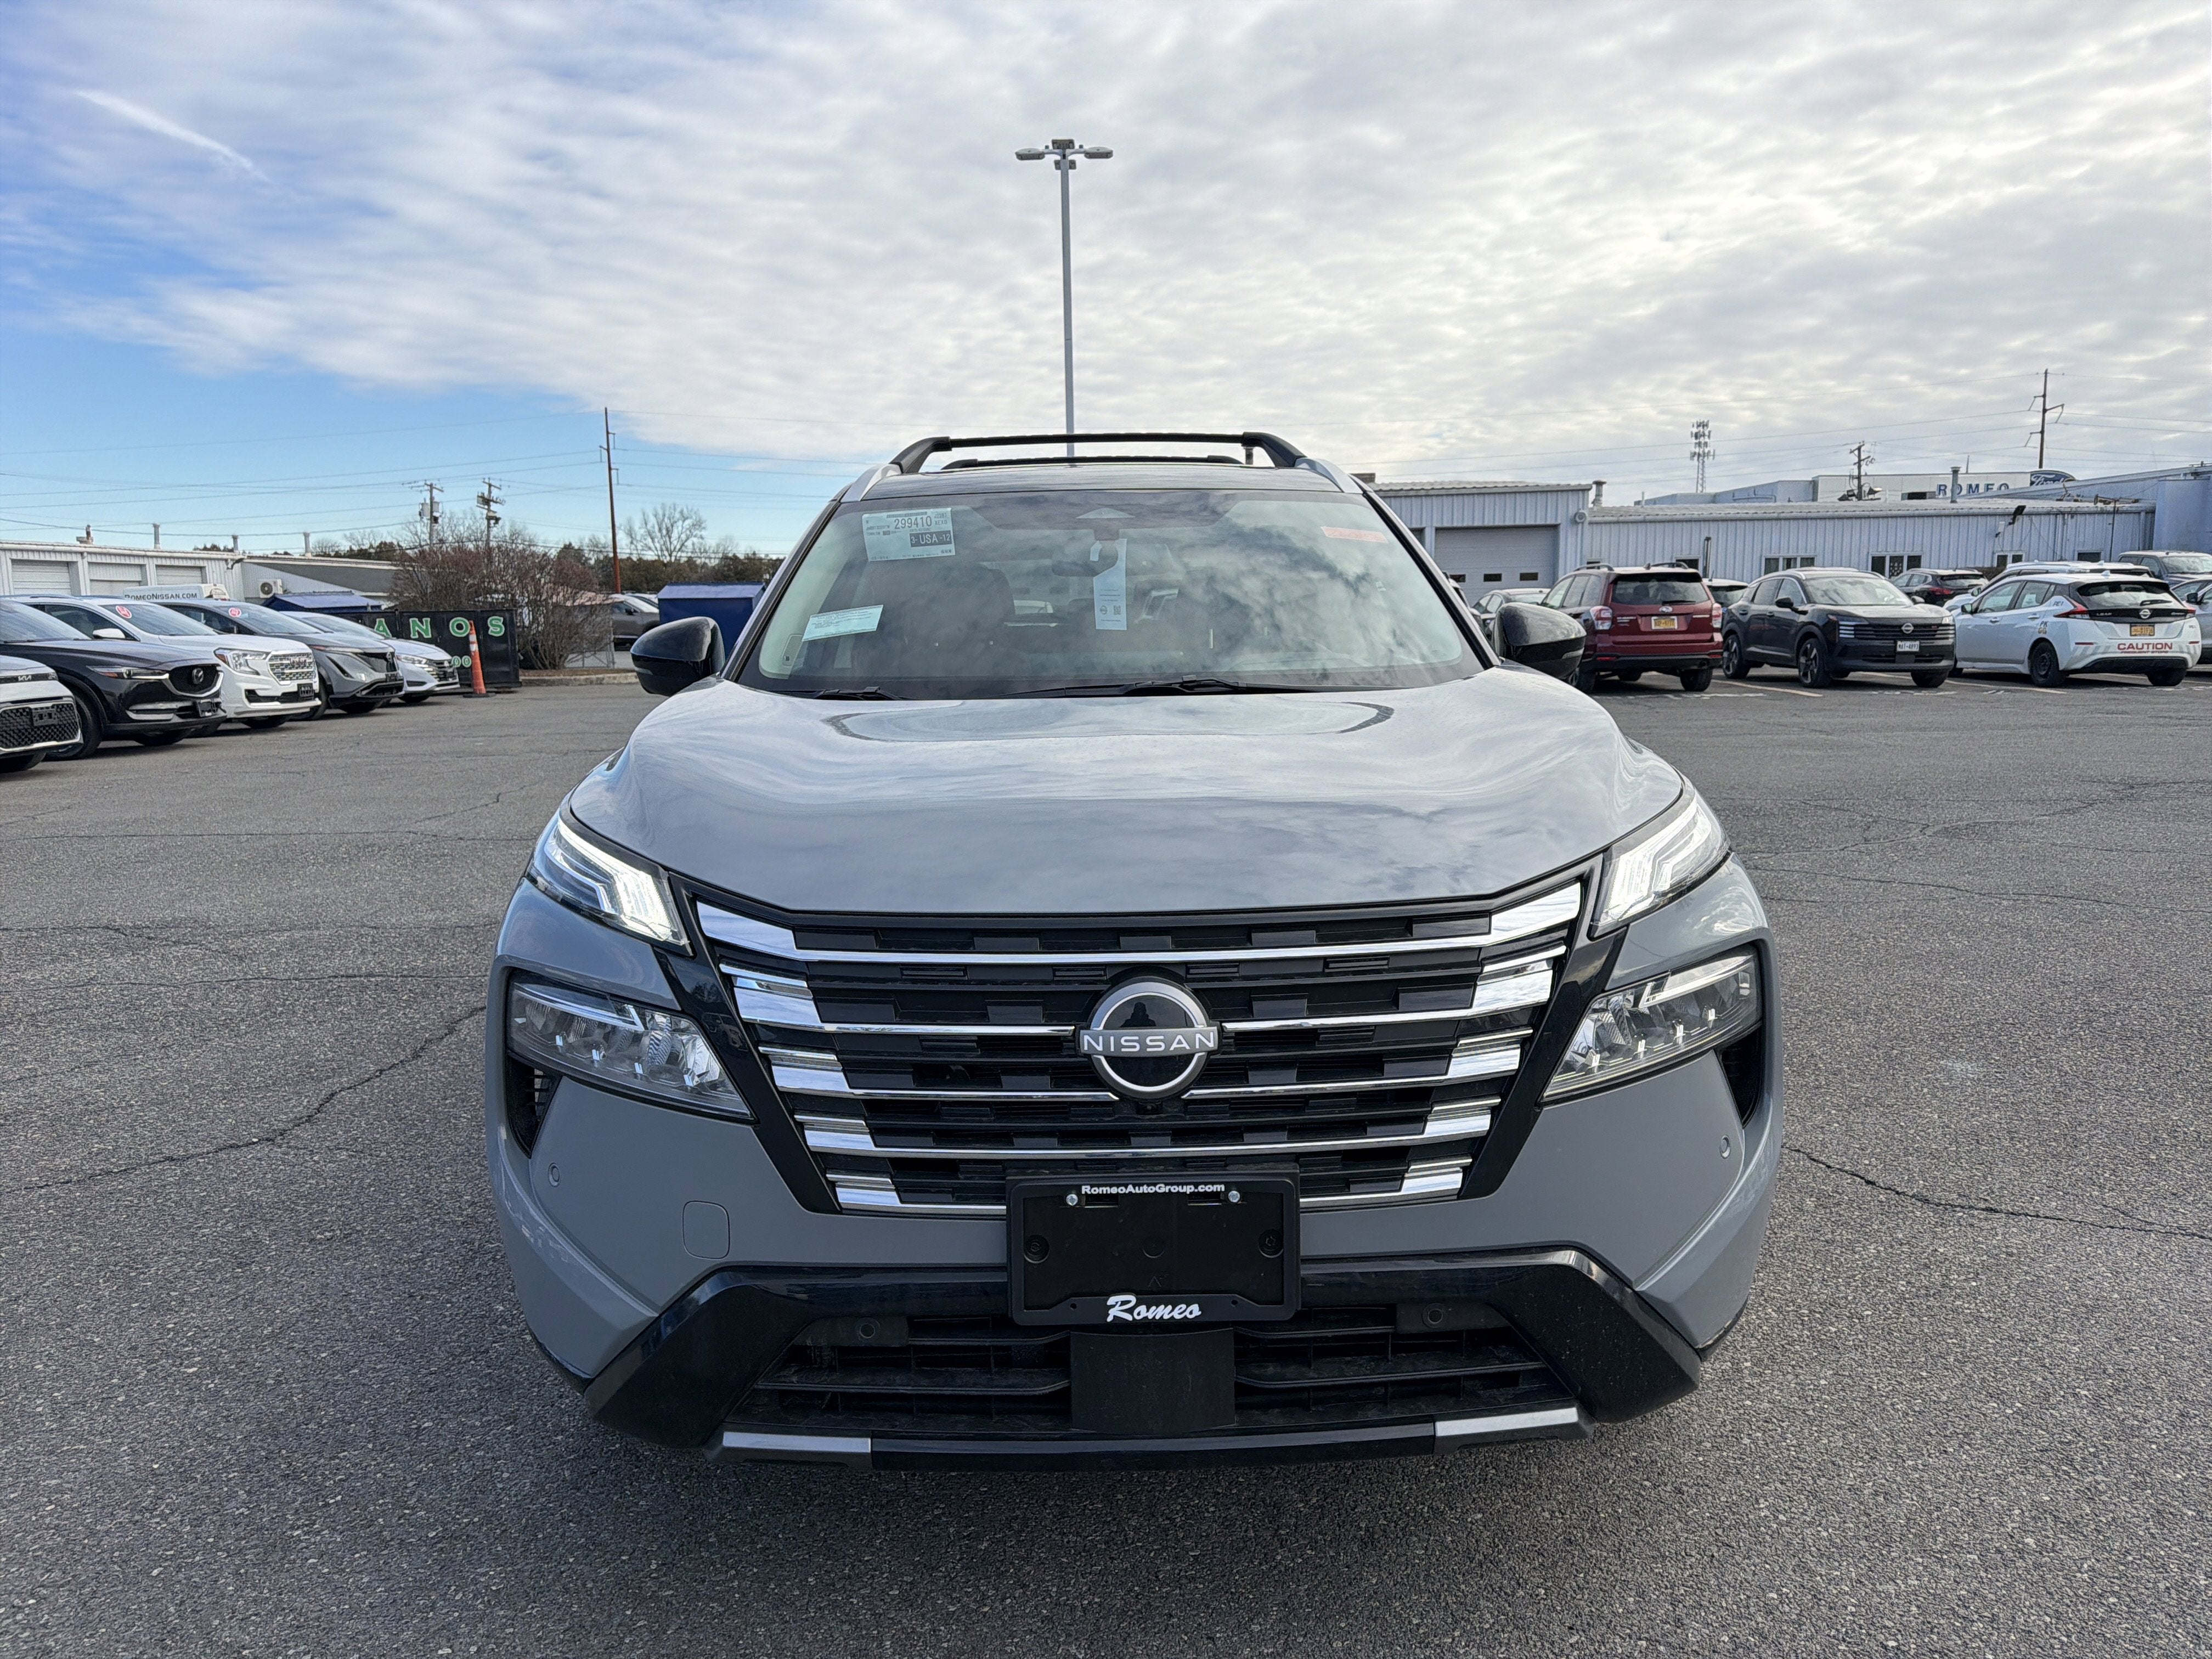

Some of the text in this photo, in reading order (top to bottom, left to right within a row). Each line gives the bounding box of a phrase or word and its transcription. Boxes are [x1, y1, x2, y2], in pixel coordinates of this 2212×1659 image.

[894, 516, 932, 529] 299410
[919, 534, 939, 544] USA
[1084, 1031, 1214, 1052] NISSAN
[1081, 1184, 1224, 1194] RomeoAutoGroup.com
[1107, 1295, 1201, 1322] Romeo
